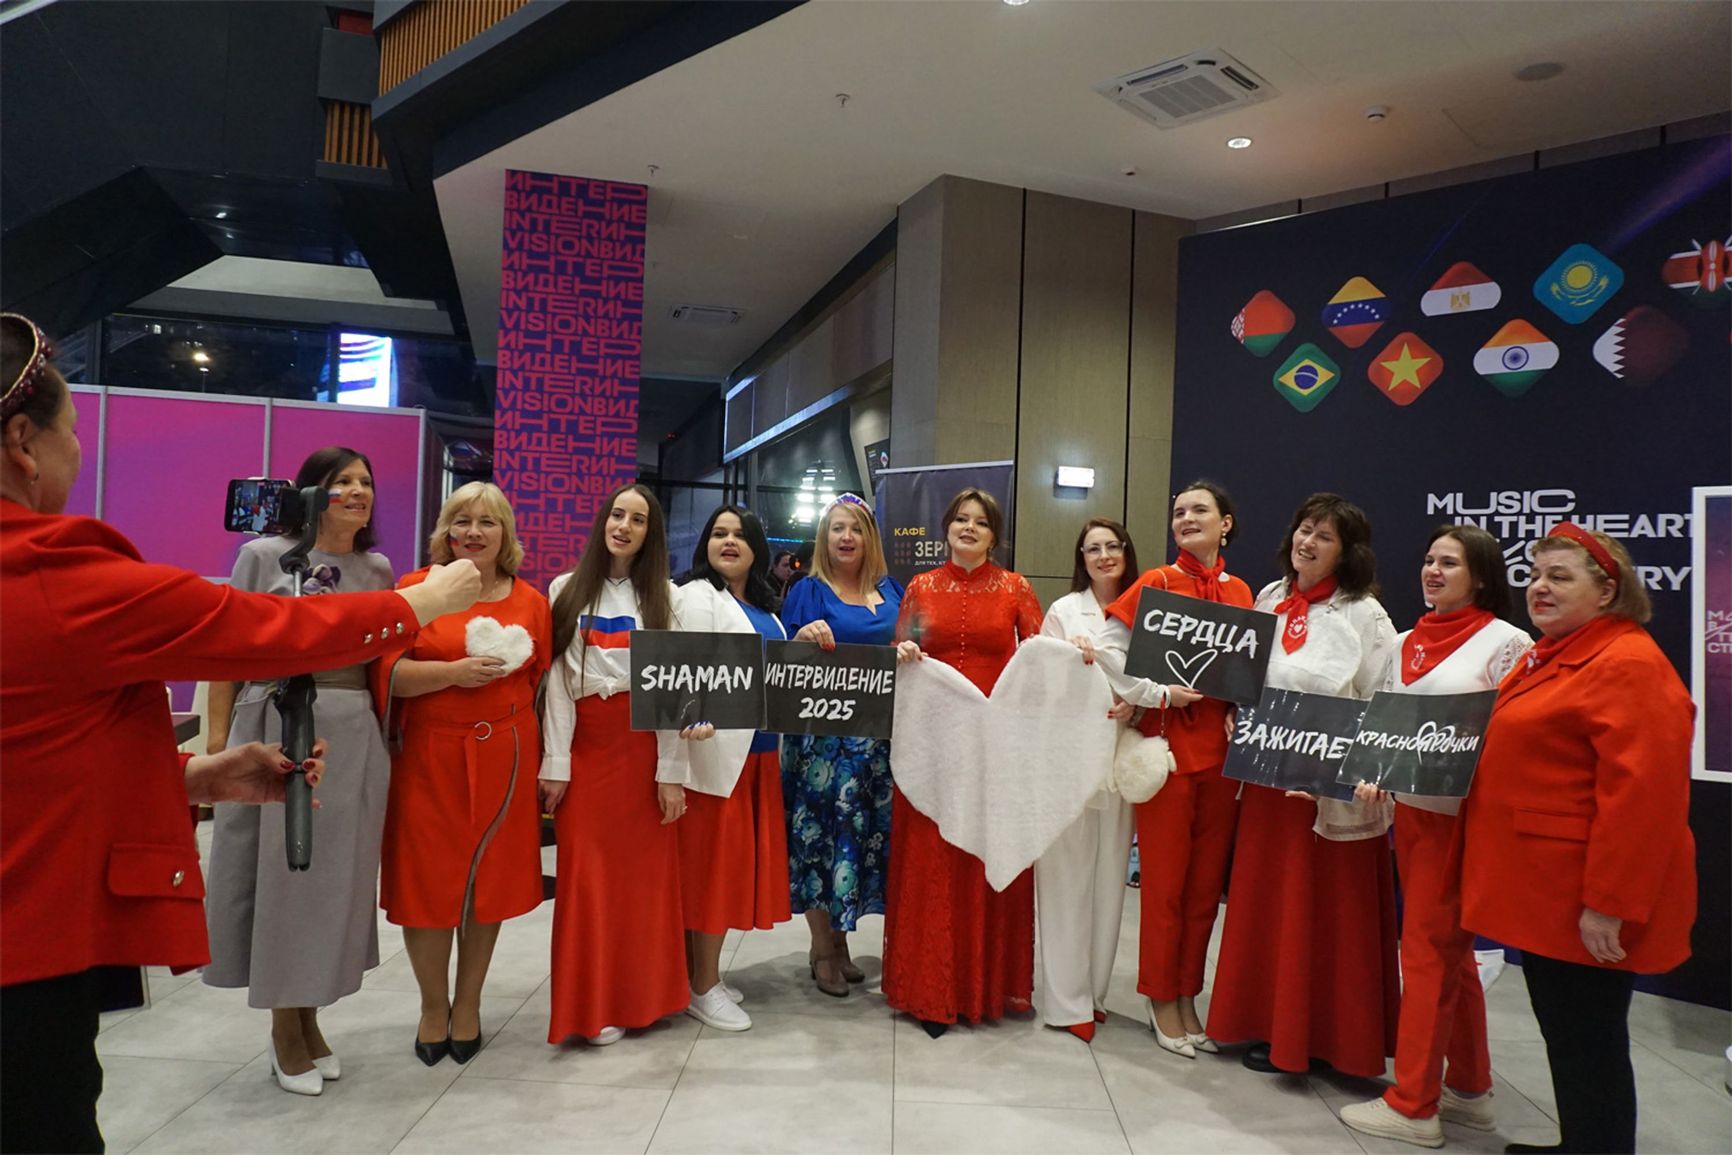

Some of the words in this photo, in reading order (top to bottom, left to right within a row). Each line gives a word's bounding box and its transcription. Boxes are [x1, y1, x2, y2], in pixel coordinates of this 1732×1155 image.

[506, 172, 646, 200] ИНТЕР
[505, 191, 646, 223] ВИДЕНИЕ
[503, 251, 644, 278] ИНТЕР
[502, 271, 643, 300] ВИДЕНИЕ
[498, 330, 640, 356] ИНТЕР
[498, 350, 640, 378] ВИДЕНИЕ
[495, 410, 637, 434] ИНТЕР
[494, 430, 637, 456] ВИДЕНИЕ
[1427, 489, 1576, 515] MUSIC
[894, 527, 926, 537] КАФЕ
[1494, 515, 1564, 538] THE
[1143, 608, 1260, 660] СЕРДЦА
[640, 664, 753, 694] SHAMAN
[765, 661, 894, 695] ИНТЕРВИДЕНИЕ
[798, 697, 856, 721] 2025
[1233, 720, 1353, 761] ЗАЖИГАЕ
